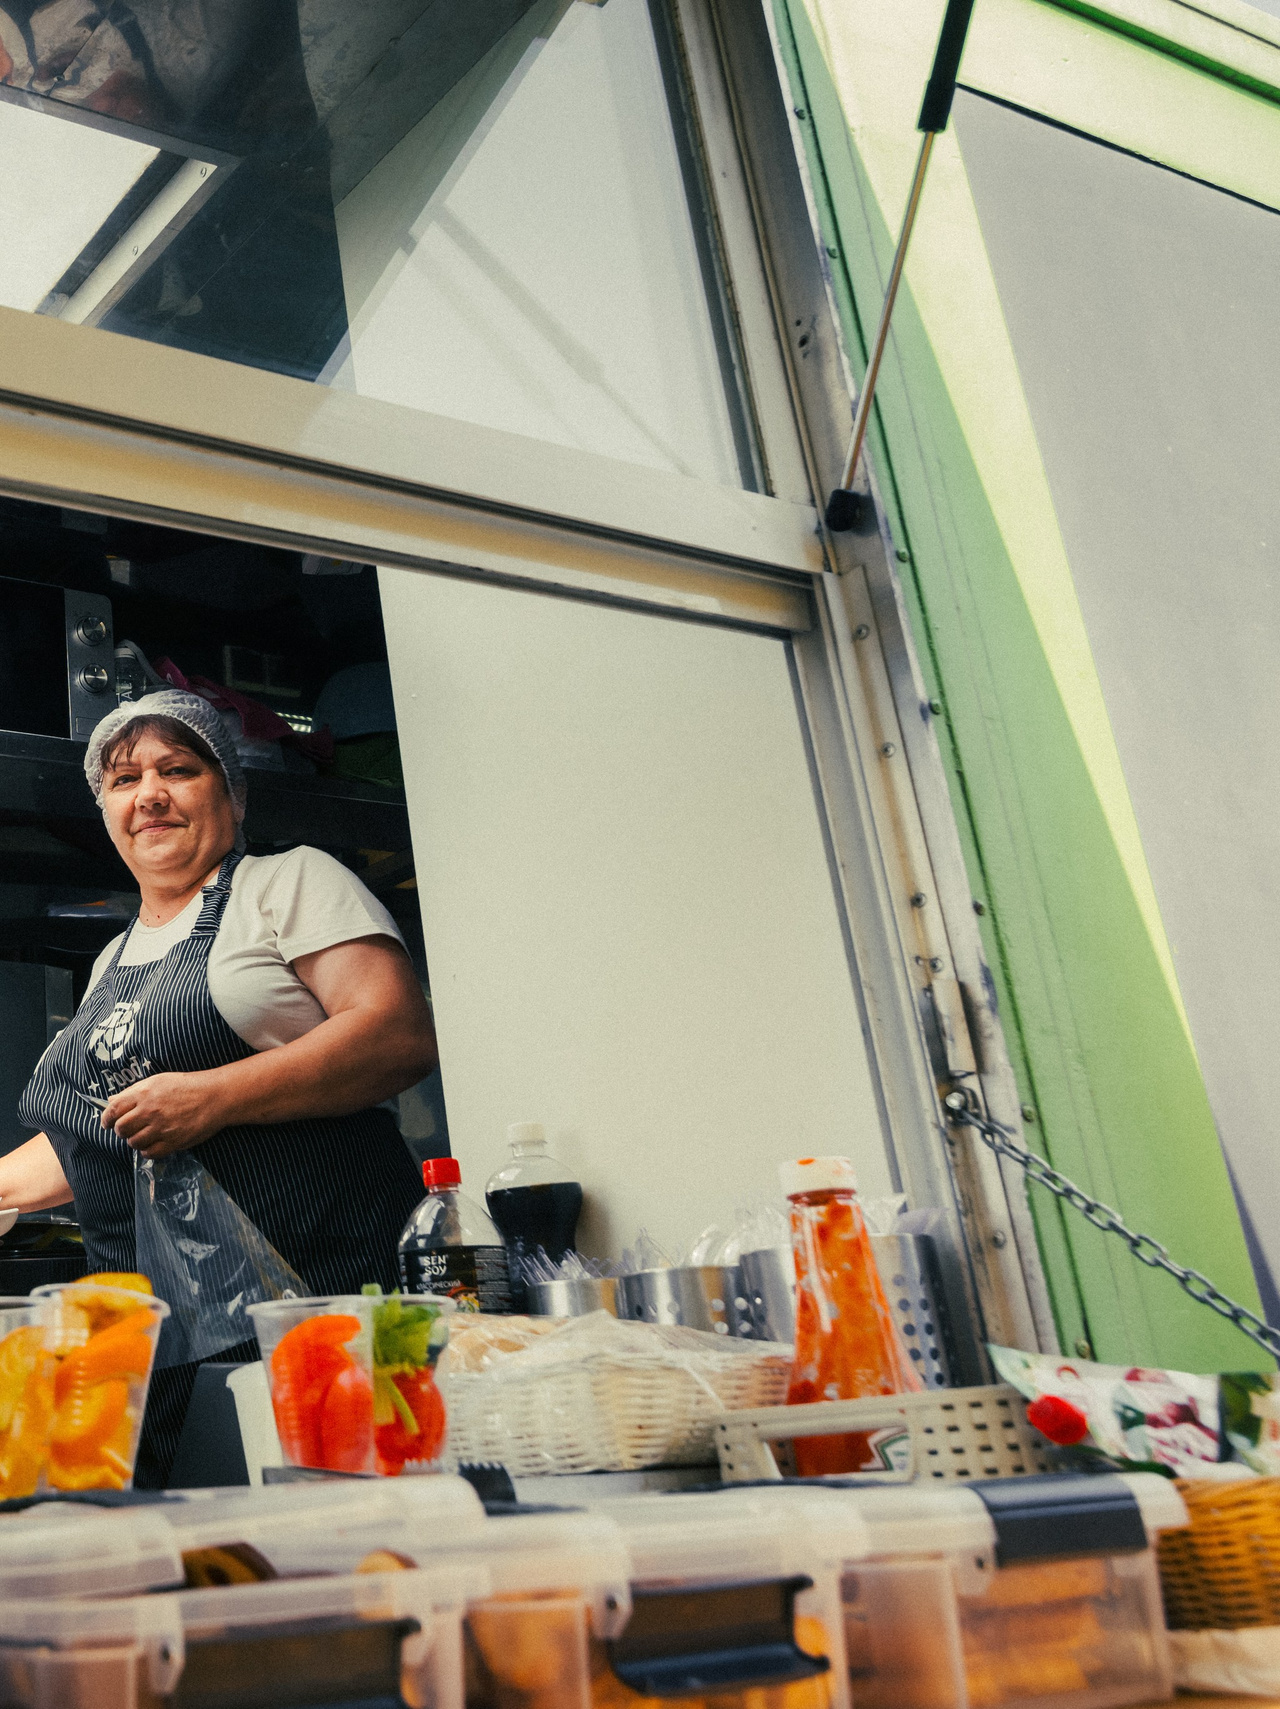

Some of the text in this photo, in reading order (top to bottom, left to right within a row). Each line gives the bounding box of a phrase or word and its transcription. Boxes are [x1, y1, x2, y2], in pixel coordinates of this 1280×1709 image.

[101, 1055, 143, 1092] Food
[423, 1254, 447, 1266] SEN
[424, 1265, 448, 1277] SOY
